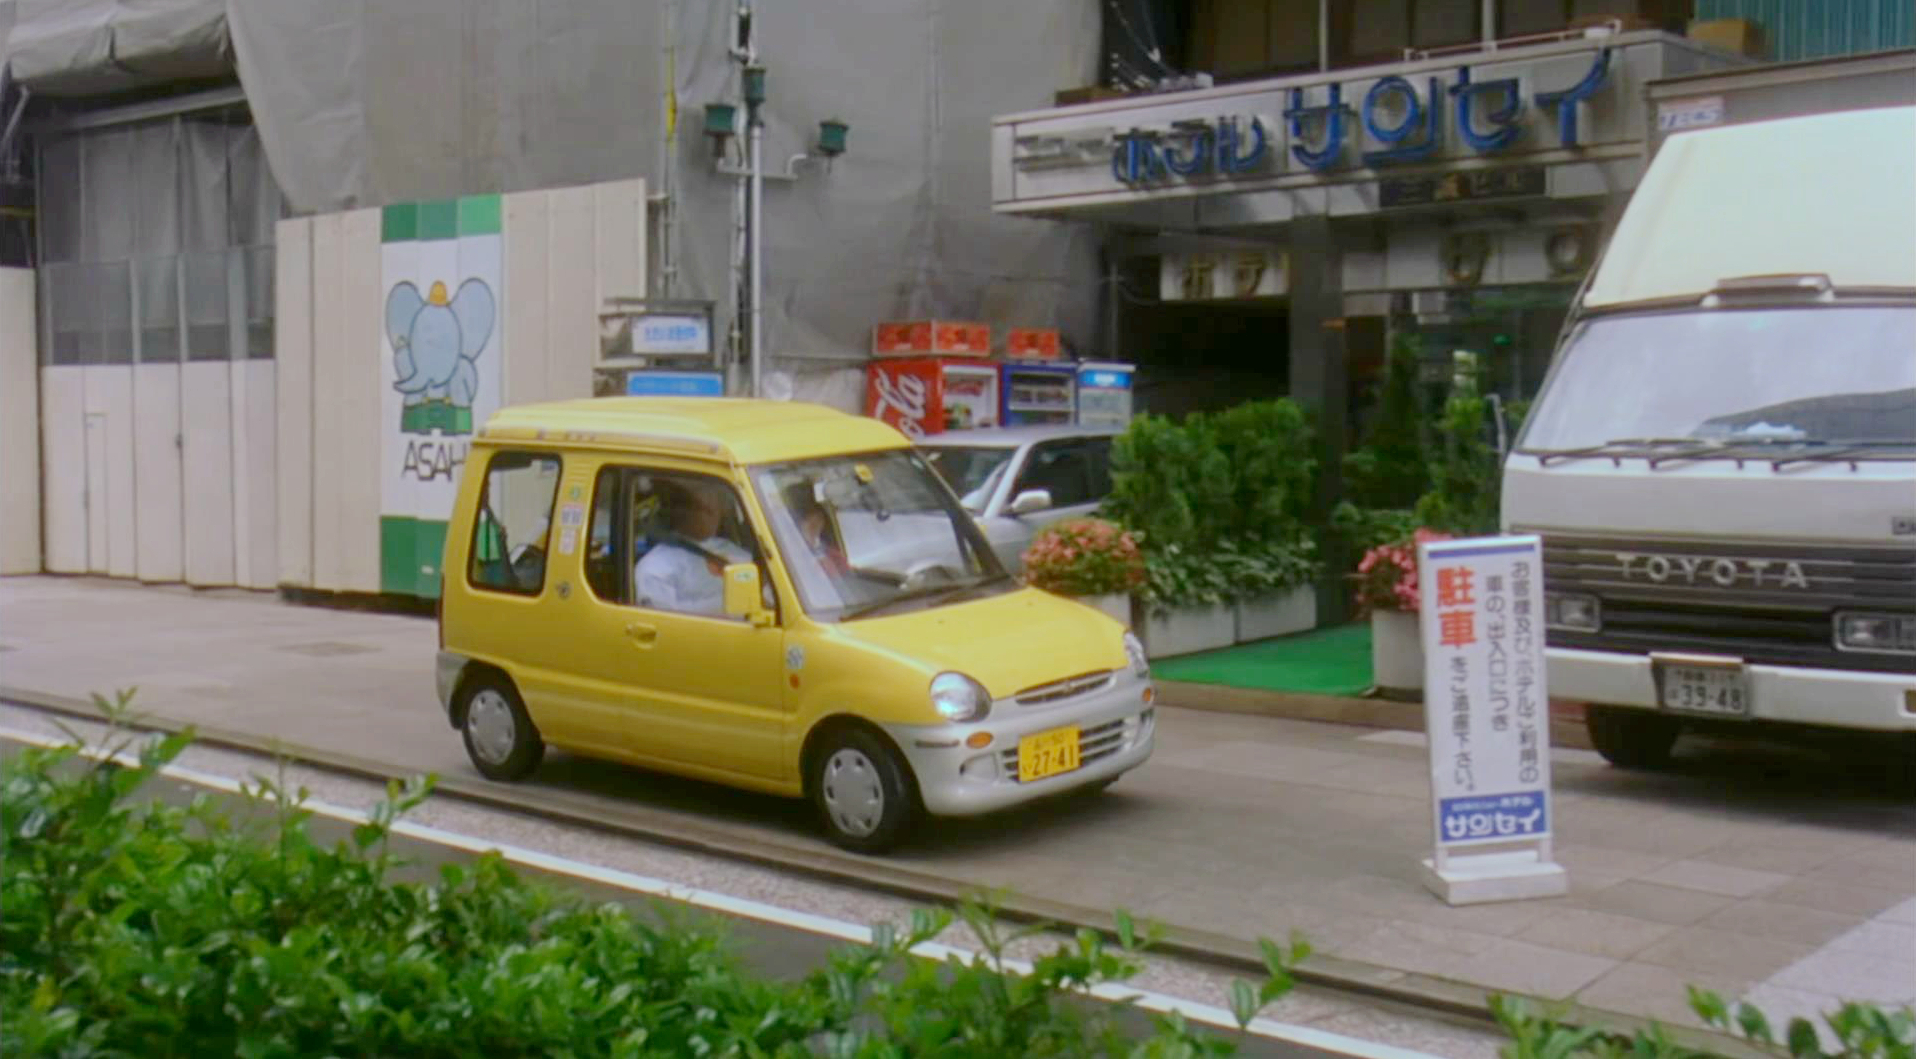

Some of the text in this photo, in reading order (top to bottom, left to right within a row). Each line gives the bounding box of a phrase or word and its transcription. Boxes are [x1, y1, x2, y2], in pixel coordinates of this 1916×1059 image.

[1111, 115, 1267, 187] ホテル
[1283, 48, 1611, 172] サンセイ
[1615, 552, 1810, 590] TOYOTA
[1444, 808, 1541, 839] サンセイ
